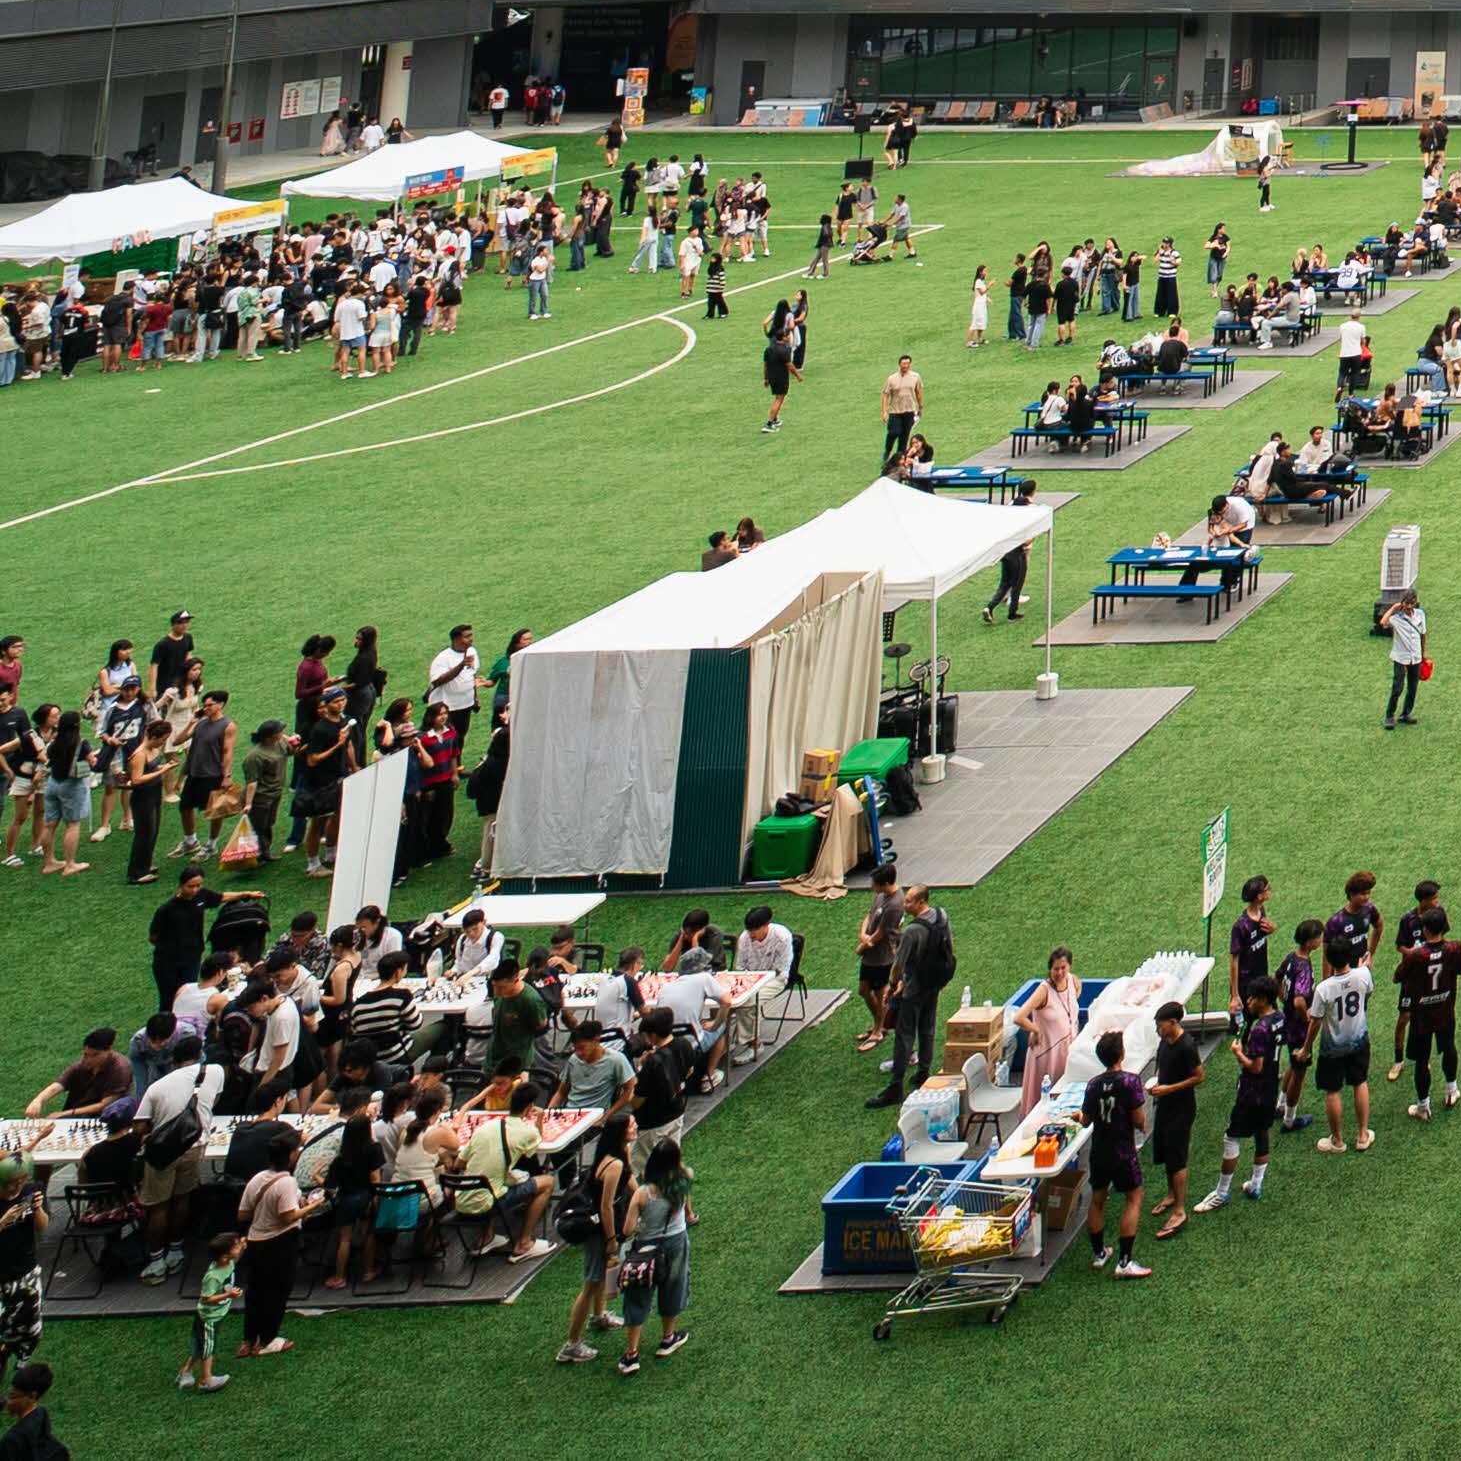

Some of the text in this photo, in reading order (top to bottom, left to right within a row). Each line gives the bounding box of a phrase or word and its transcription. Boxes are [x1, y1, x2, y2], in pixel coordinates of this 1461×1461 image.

[1427, 963, 1443, 991] 7
[1334, 991, 1360, 1022] 18
[843, 1230, 872, 1251] ICE
